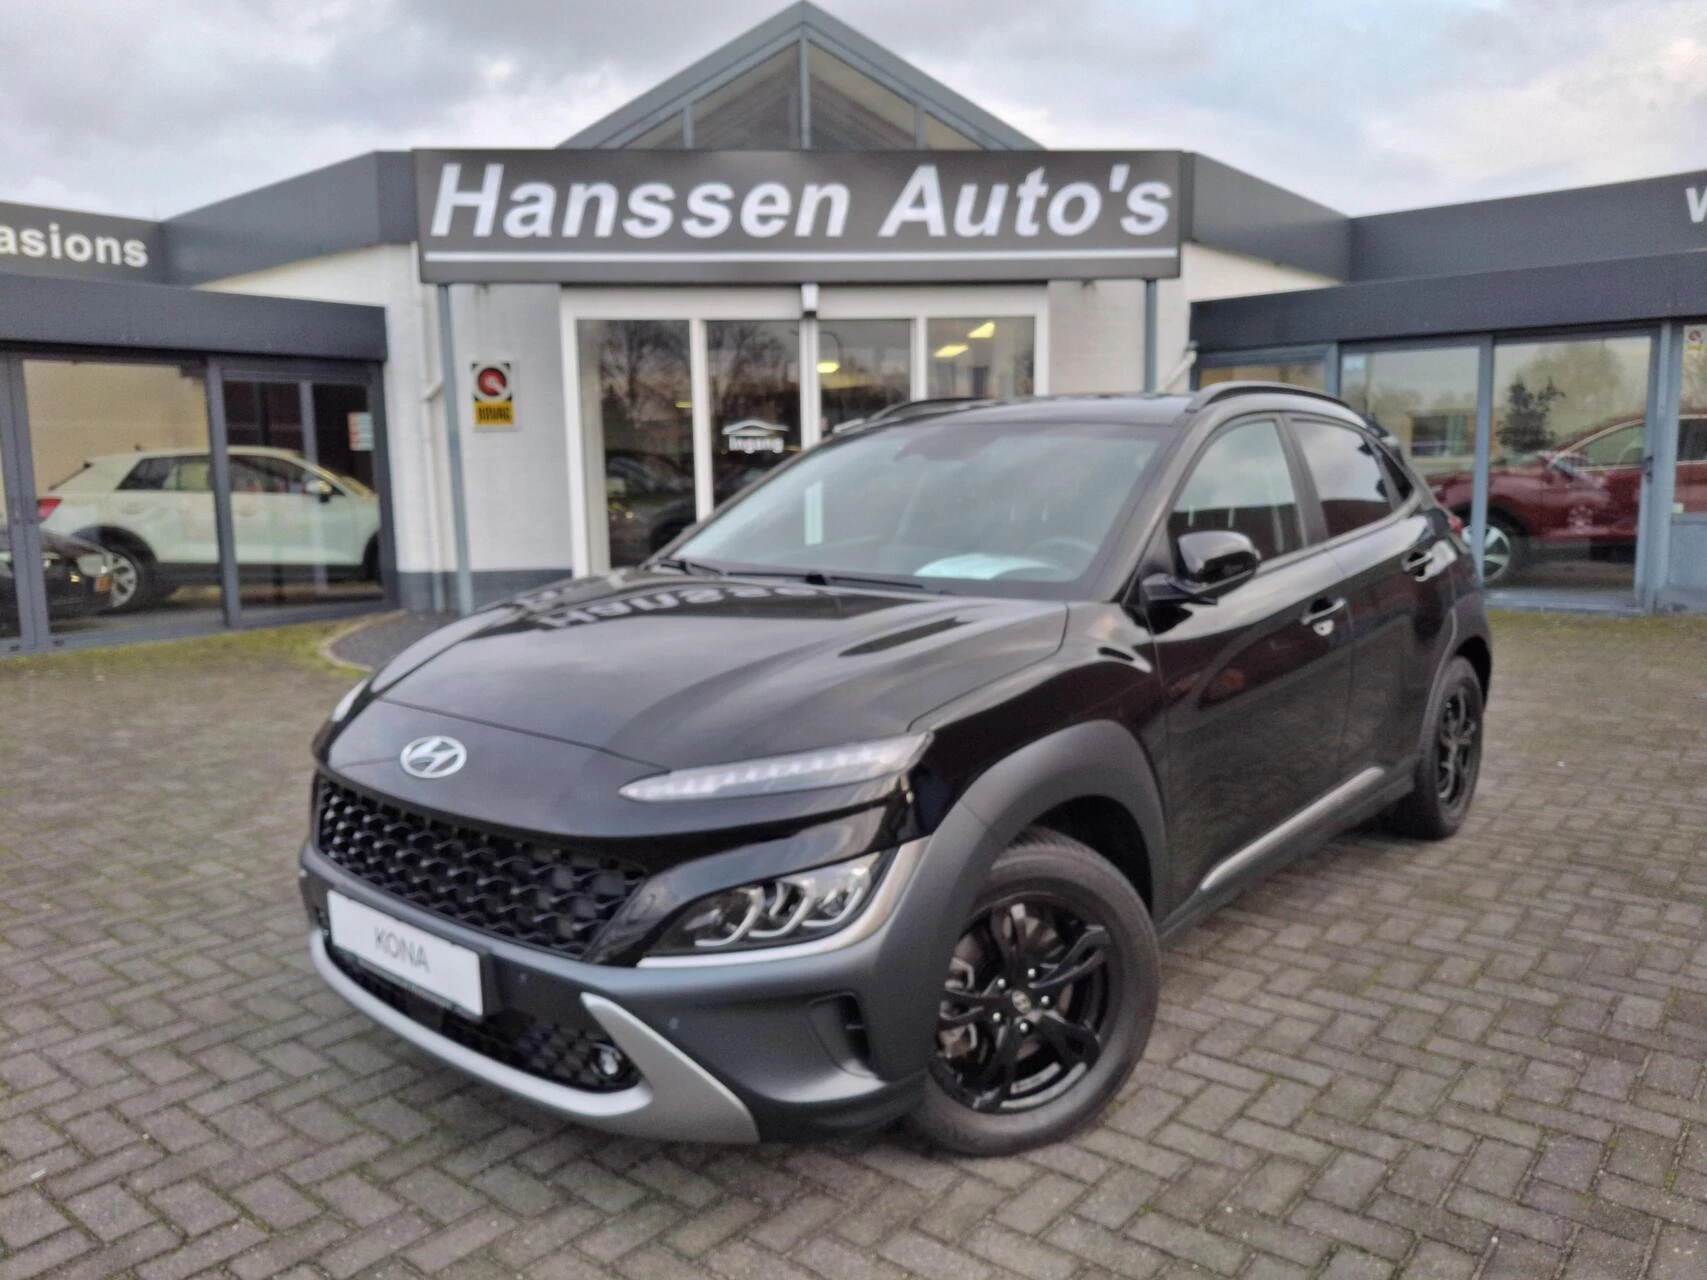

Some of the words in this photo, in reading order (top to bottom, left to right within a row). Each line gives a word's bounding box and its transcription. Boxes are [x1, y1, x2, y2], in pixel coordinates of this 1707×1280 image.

[430, 163, 851, 239] Hanssen
[879, 163, 1173, 239] Auto's
[374, 925, 431, 973] KONA
